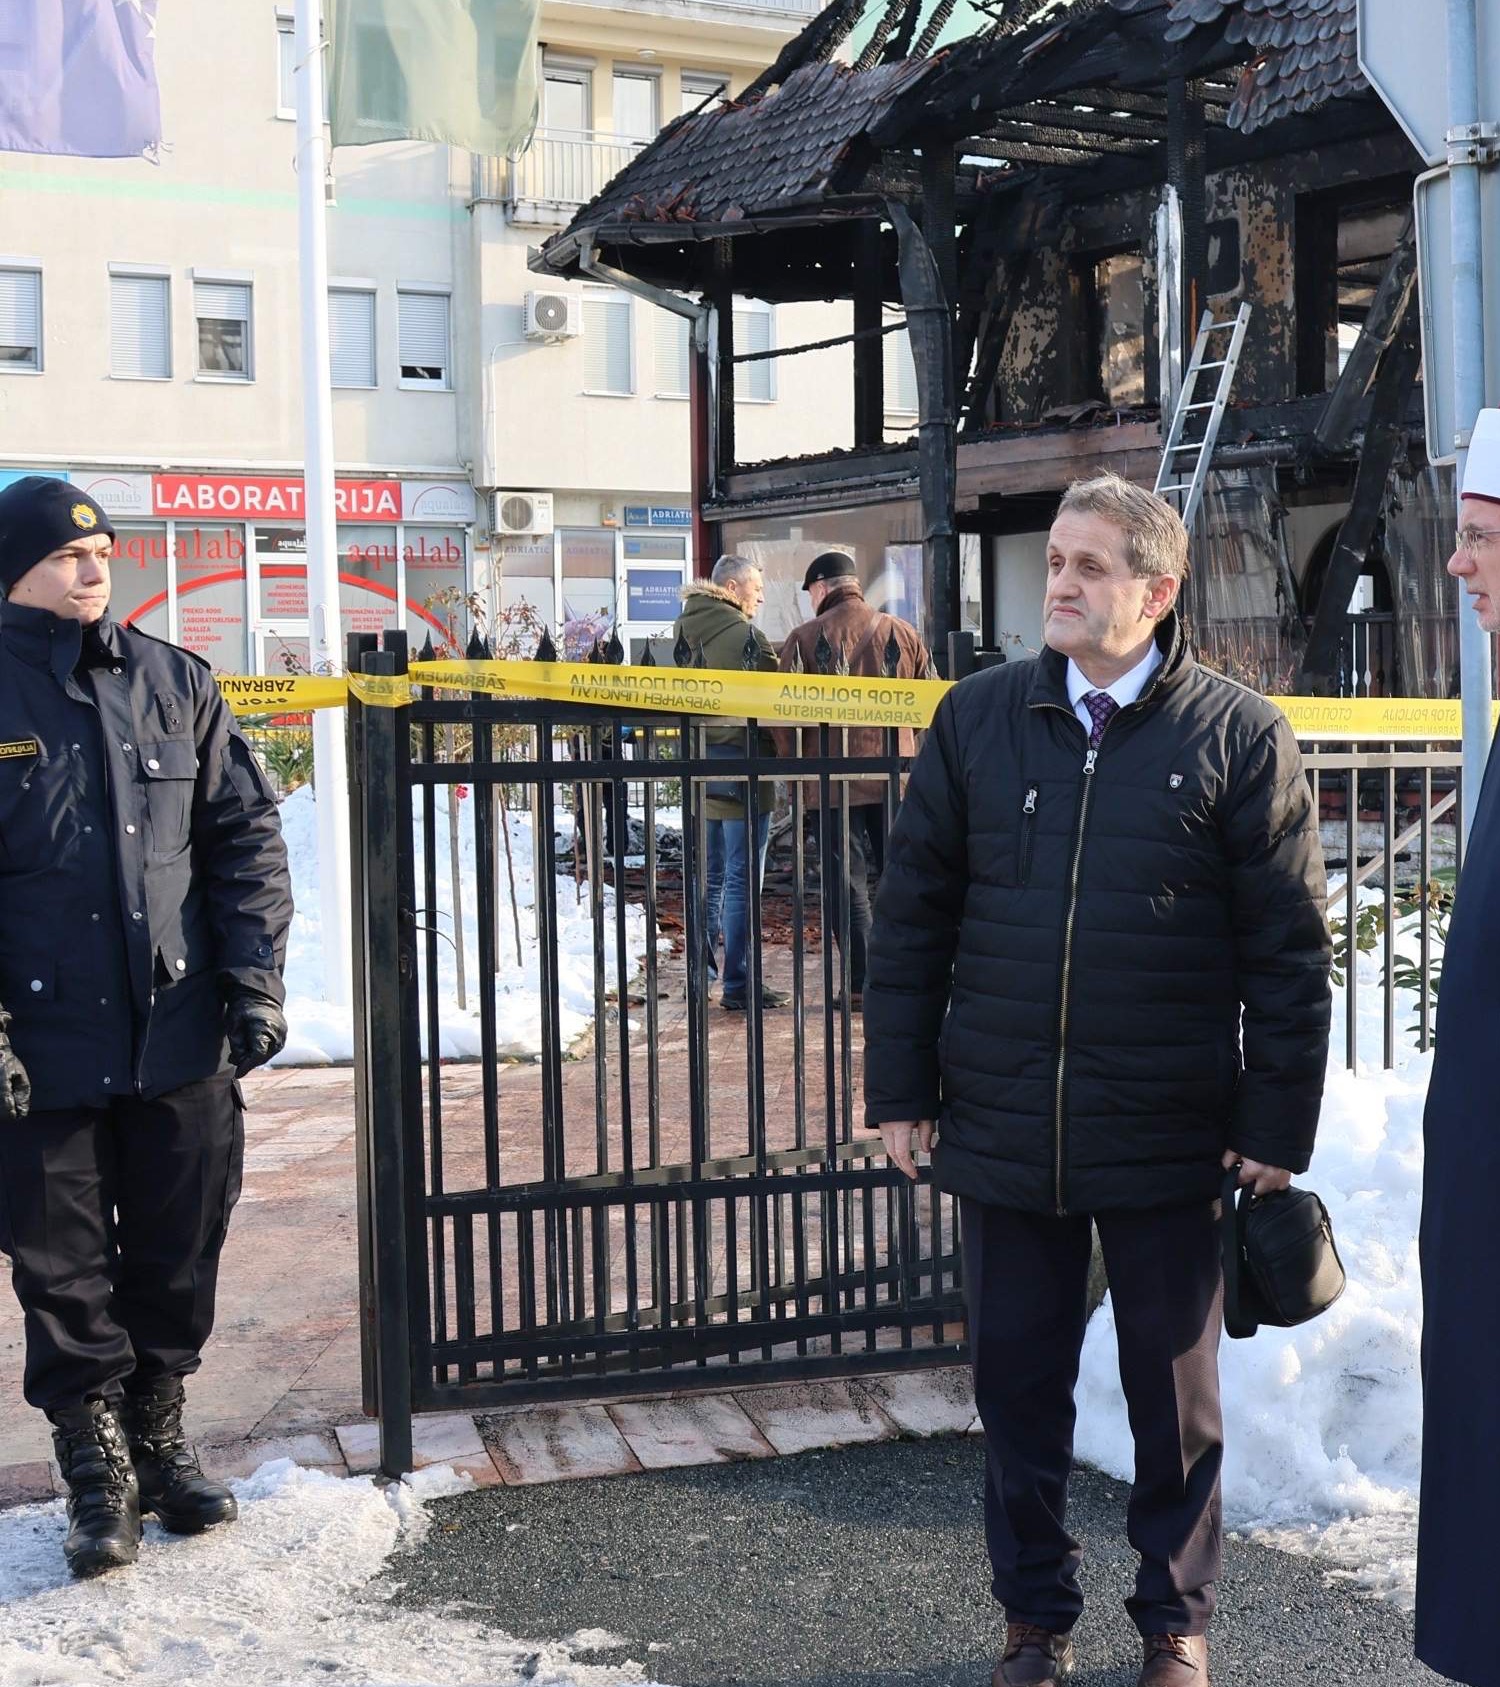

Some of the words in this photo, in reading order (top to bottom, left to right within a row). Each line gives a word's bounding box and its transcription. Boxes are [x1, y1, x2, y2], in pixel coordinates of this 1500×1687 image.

[156, 484, 398, 514] LABORATRIJA
[347, 536, 461, 571] aqualab
[504, 545, 550, 555] ADRIATIC
[0, 744, 34, 755] ОЛИЦИЈА
